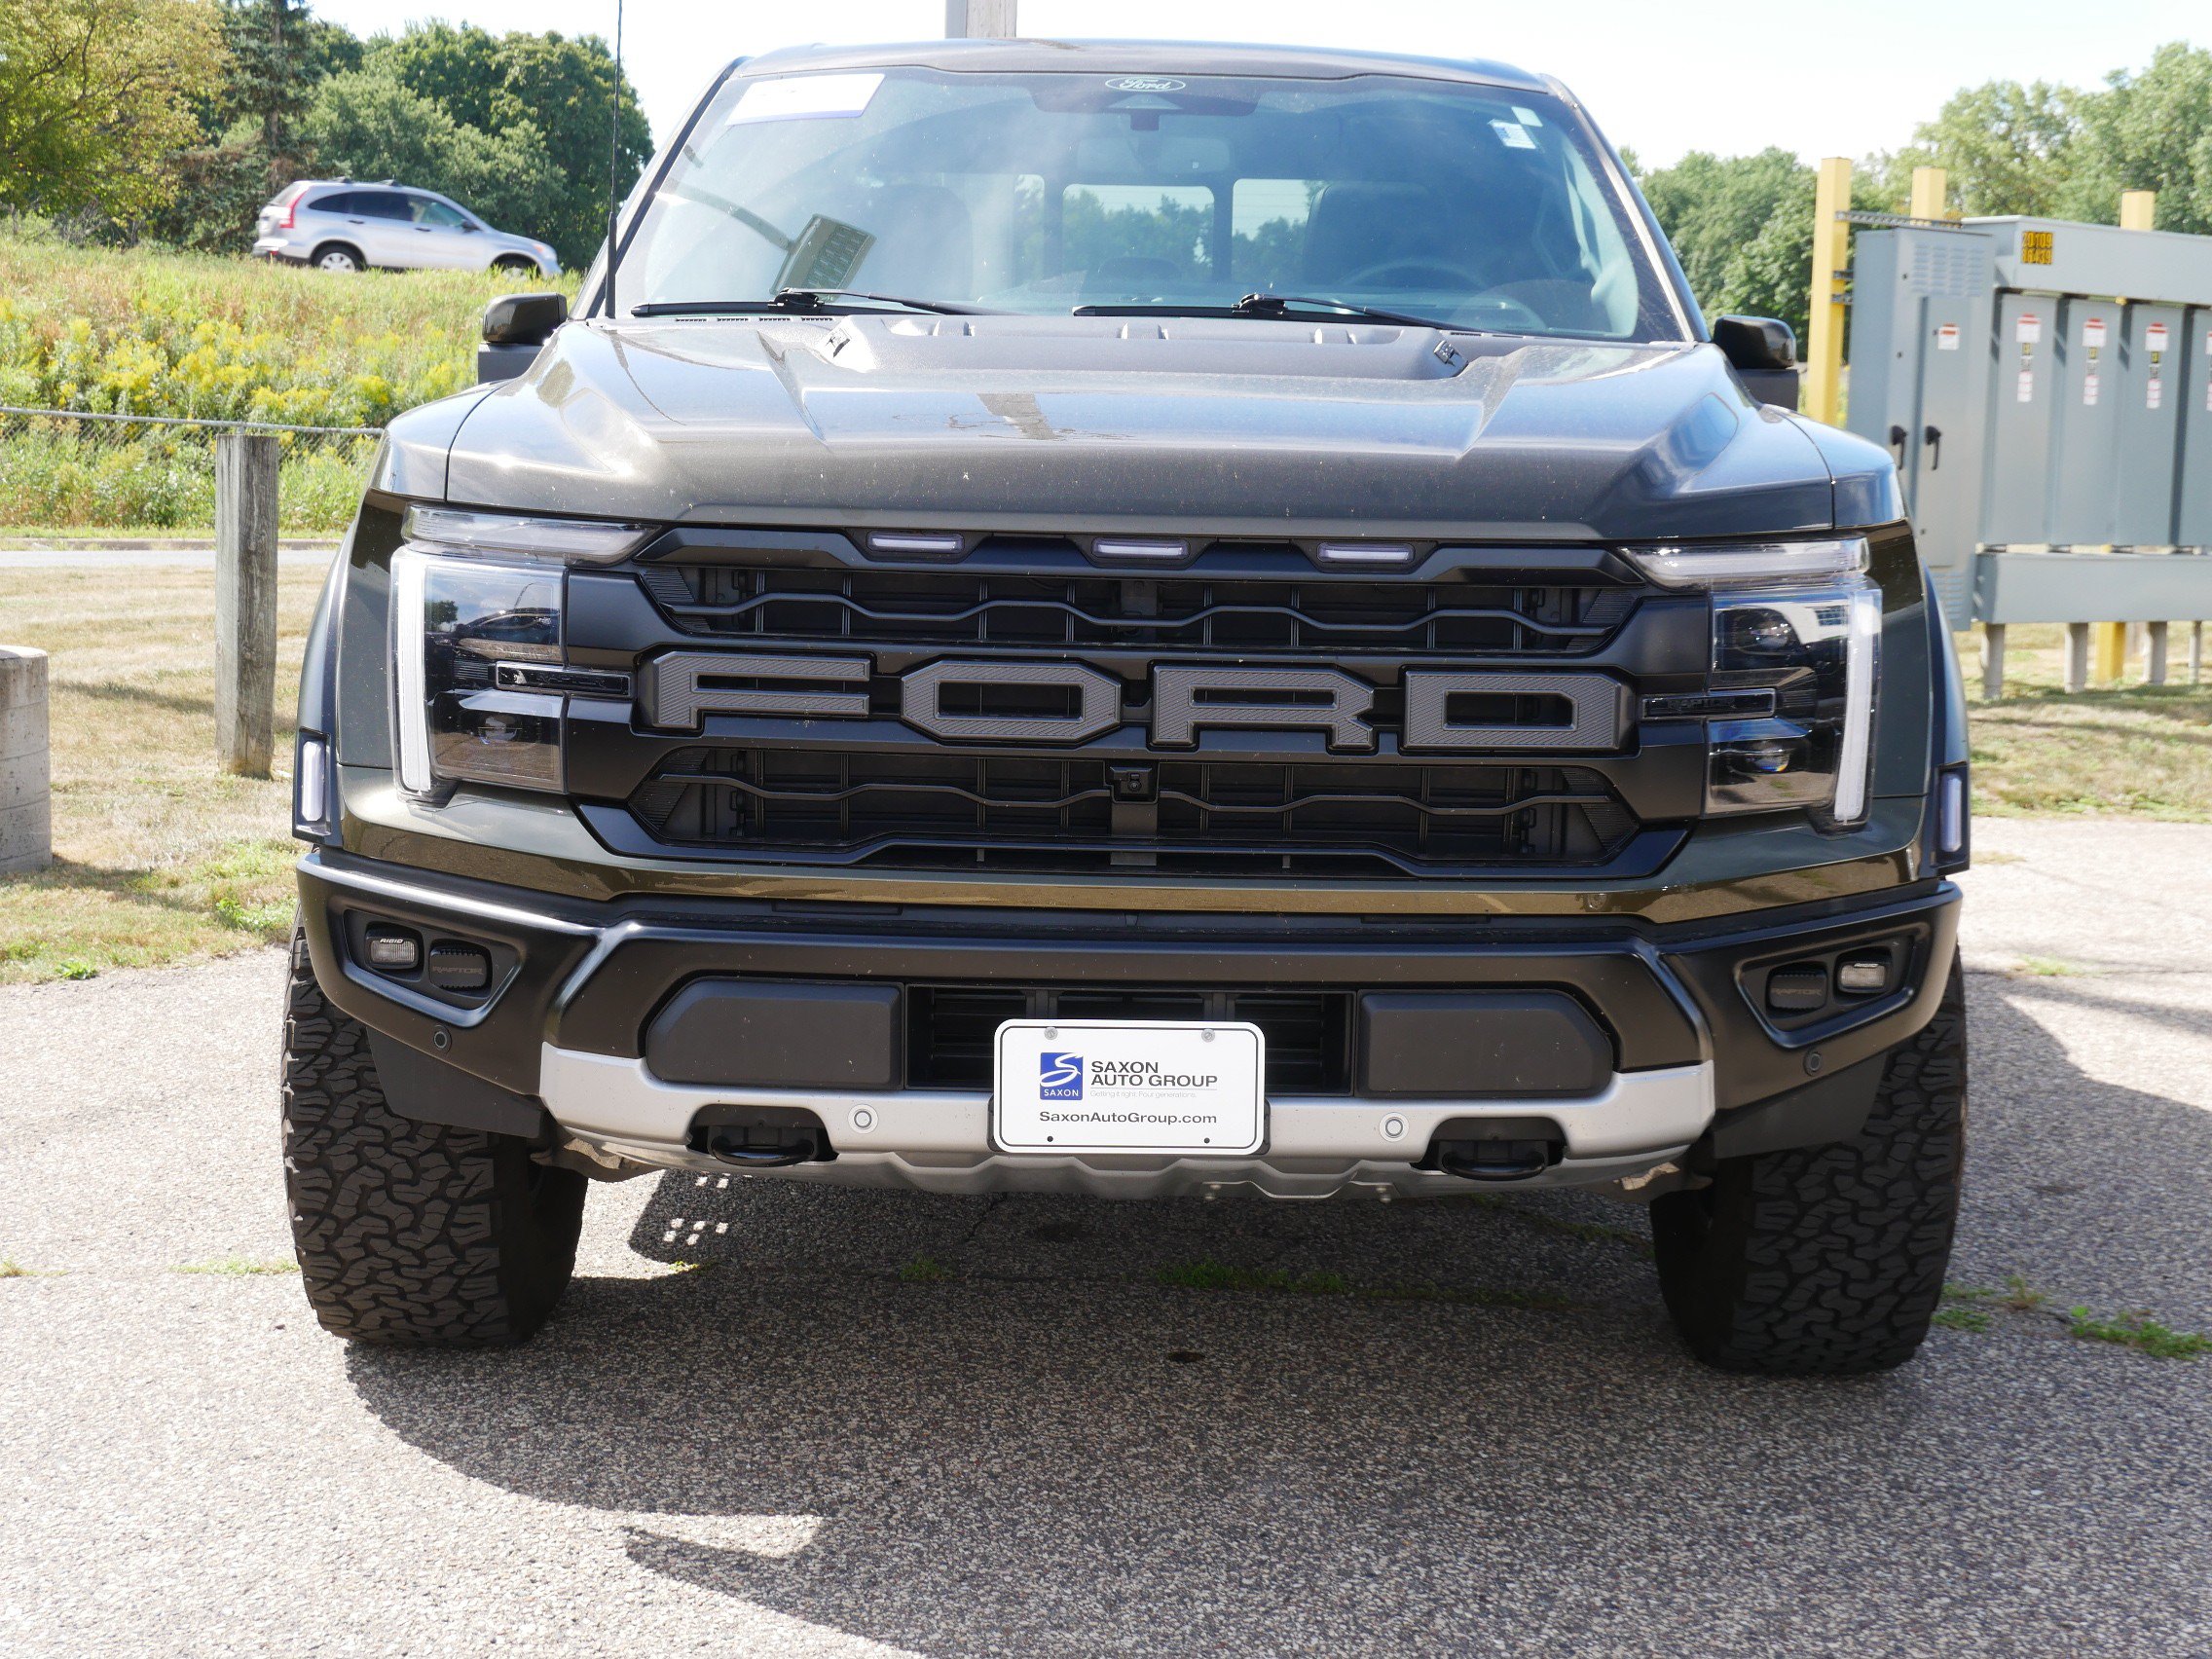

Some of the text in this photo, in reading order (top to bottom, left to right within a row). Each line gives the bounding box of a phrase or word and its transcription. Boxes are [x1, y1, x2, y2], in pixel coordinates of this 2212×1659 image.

[1119, 78, 1172, 90] Ford
[651, 650, 1622, 751] FORD
[432, 966, 483, 975] RAPTOR
[1090, 1060, 1159, 1074] SAXON
[1090, 1074, 1218, 1088] AUTO GROUP
[1044, 1088, 1079, 1097] SAXON
[1090, 1090, 1116, 1099] Getting
[1039, 1111, 1217, 1124] SaxonAutoGroup.com
